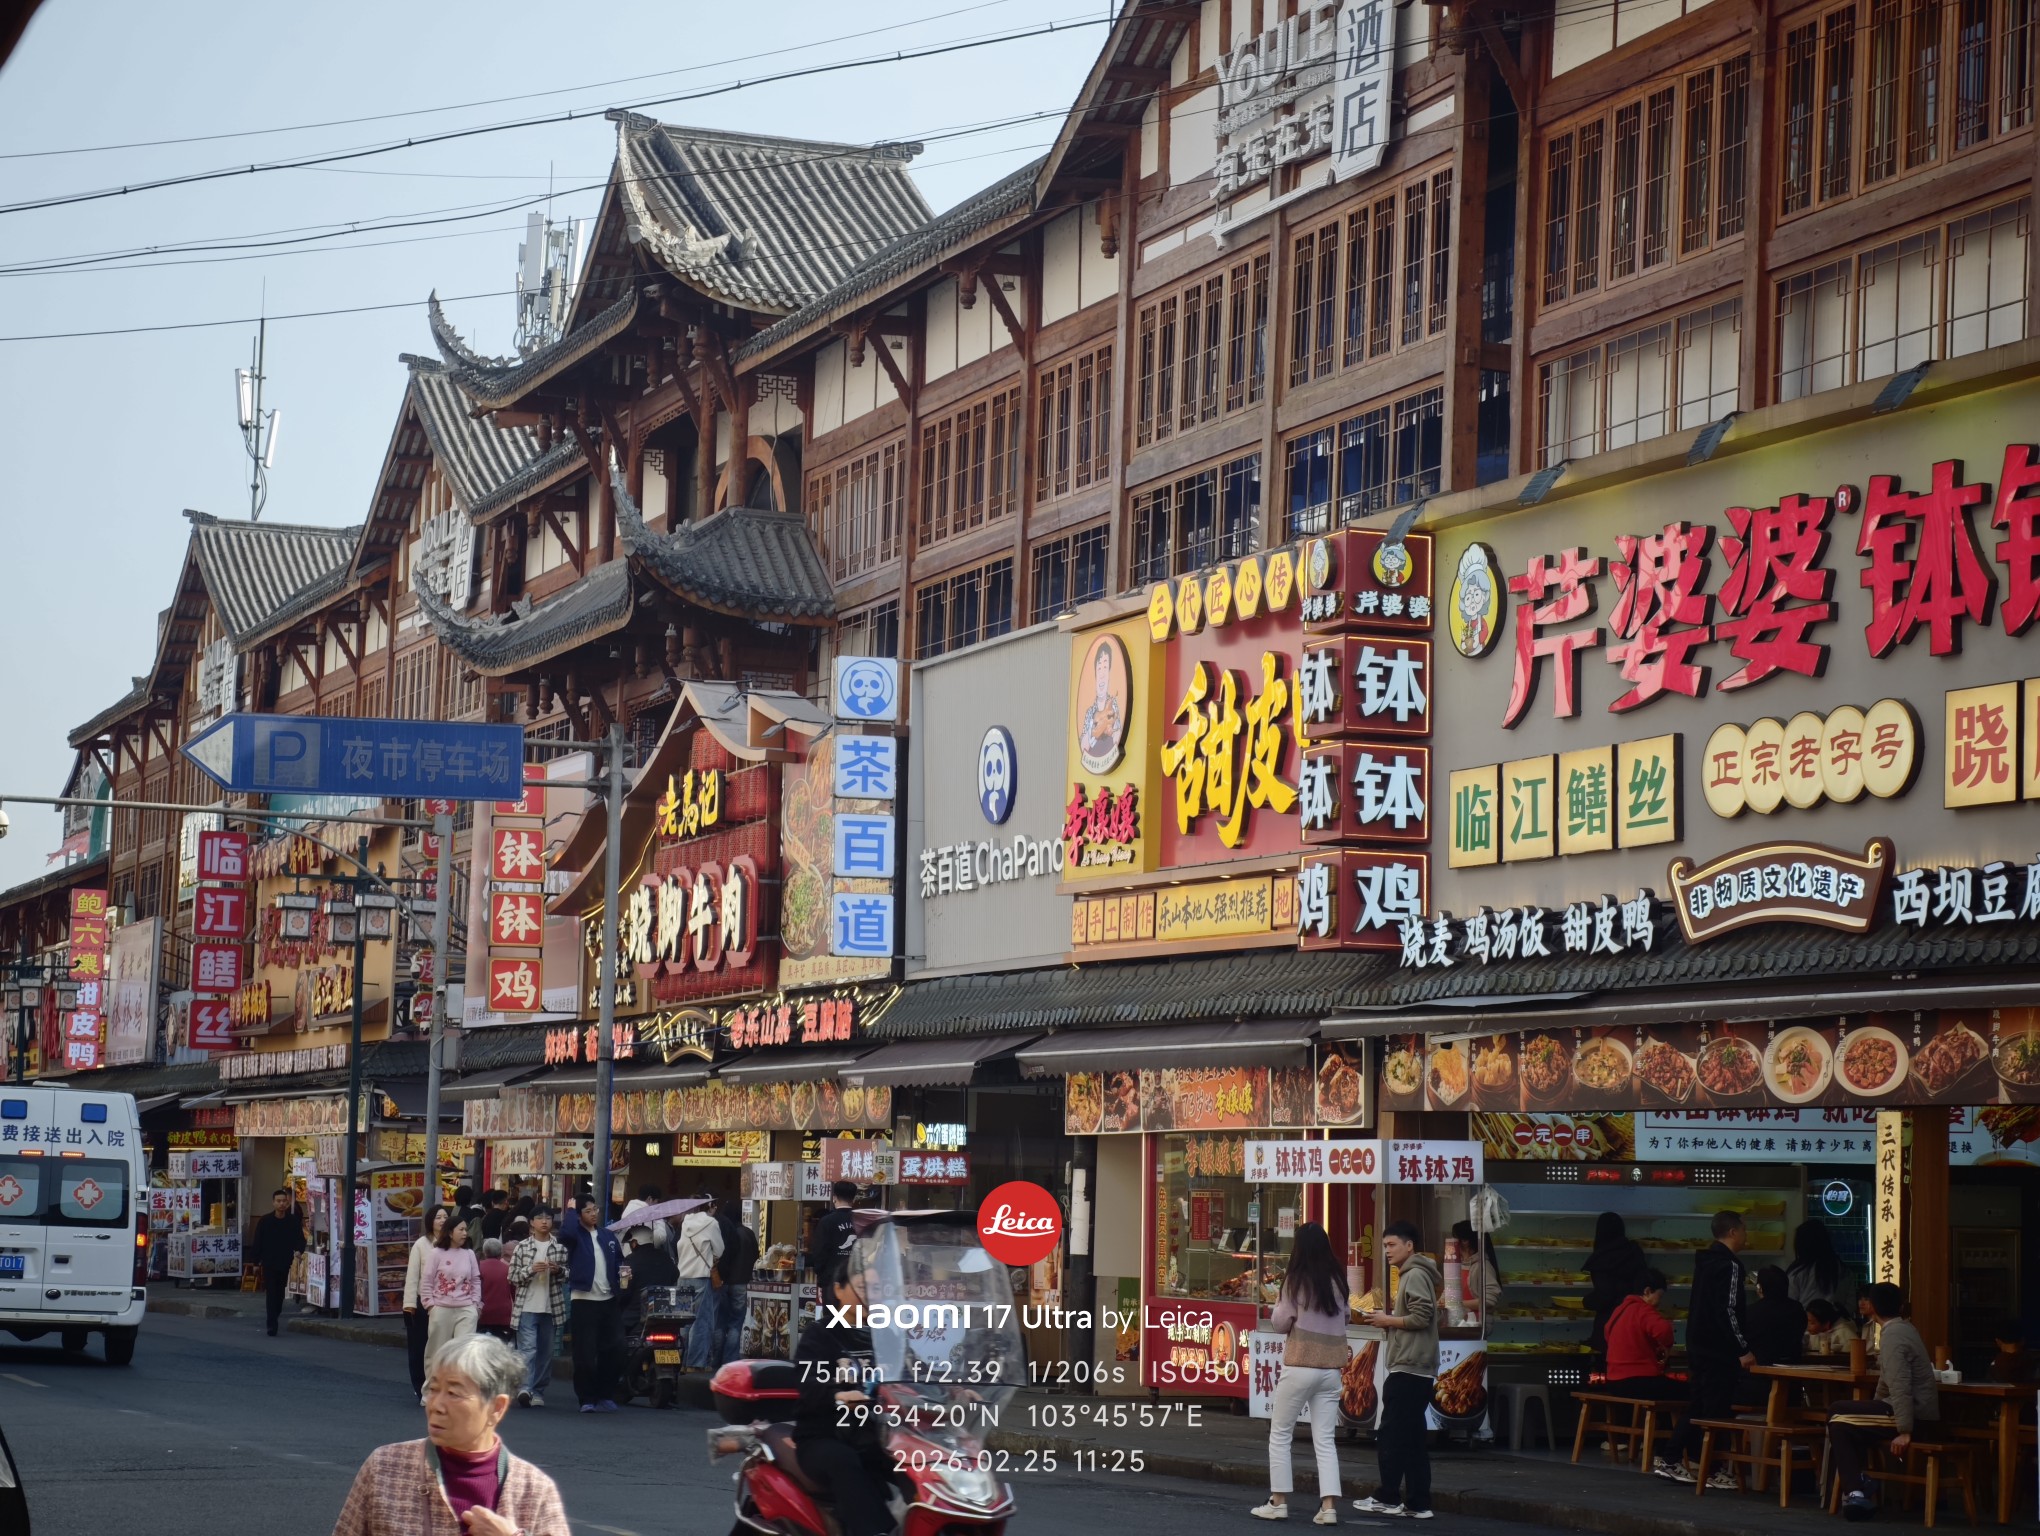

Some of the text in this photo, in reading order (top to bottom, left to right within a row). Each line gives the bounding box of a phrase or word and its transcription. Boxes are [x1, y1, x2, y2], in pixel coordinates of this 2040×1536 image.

[1339, 0, 1384, 163] 酒店
[1152, 557, 1303, 627] 三代匠心传
[1355, 589, 1432, 620] 芹婆婆
[1502, 493, 1838, 730] 芹婆婆
[341, 736, 510, 784] 夜市停车场
[1161, 650, 1310, 850] 甜皮
[1709, 722, 1903, 790] 正宗老字号
[1296, 646, 1337, 938] 钵钵鸡
[1355, 644, 1427, 935] 钵钵鸡
[1455, 754, 1669, 853] 临江鳝丝
[838, 739, 891, 952] 茶百道
[919, 842, 975, 898] 茶百道
[492, 830, 542, 1008] 钵钵鸡
[1073, 898, 1153, 938] 纯手工制作
[1159, 884, 1268, 933] 乐山本地人强烈推荐
[1690, 862, 1866, 918] 非物质文化遗产
[195, 837, 242, 1044] 临江鳝丝
[1397, 888, 1654, 968] 烧麦 鸡汤饭 甜皮鸭
[2, 1124, 125, 1147] 费接送出入院
[198, 1158, 241, 1173] 米花糖
[1275, 1146, 1373, 1177] 钵钵鸡 一元一串
[1515, 1125, 1593, 1144] 一元一串
[1648, 1136, 1777, 1151] 为了你和他人的健康
[1785, 1138, 1856, 1153] 请勤拿少取
[901, 1155, 967, 1179] 蛋烘糕
[1398, 1154, 1475, 1183] 钵钵鸡
[1880, 1124, 1896, 1222] 三代传承
[198, 1239, 241, 1254] 米花糖
[1158, 1187, 1167, 1285] 免费真空
